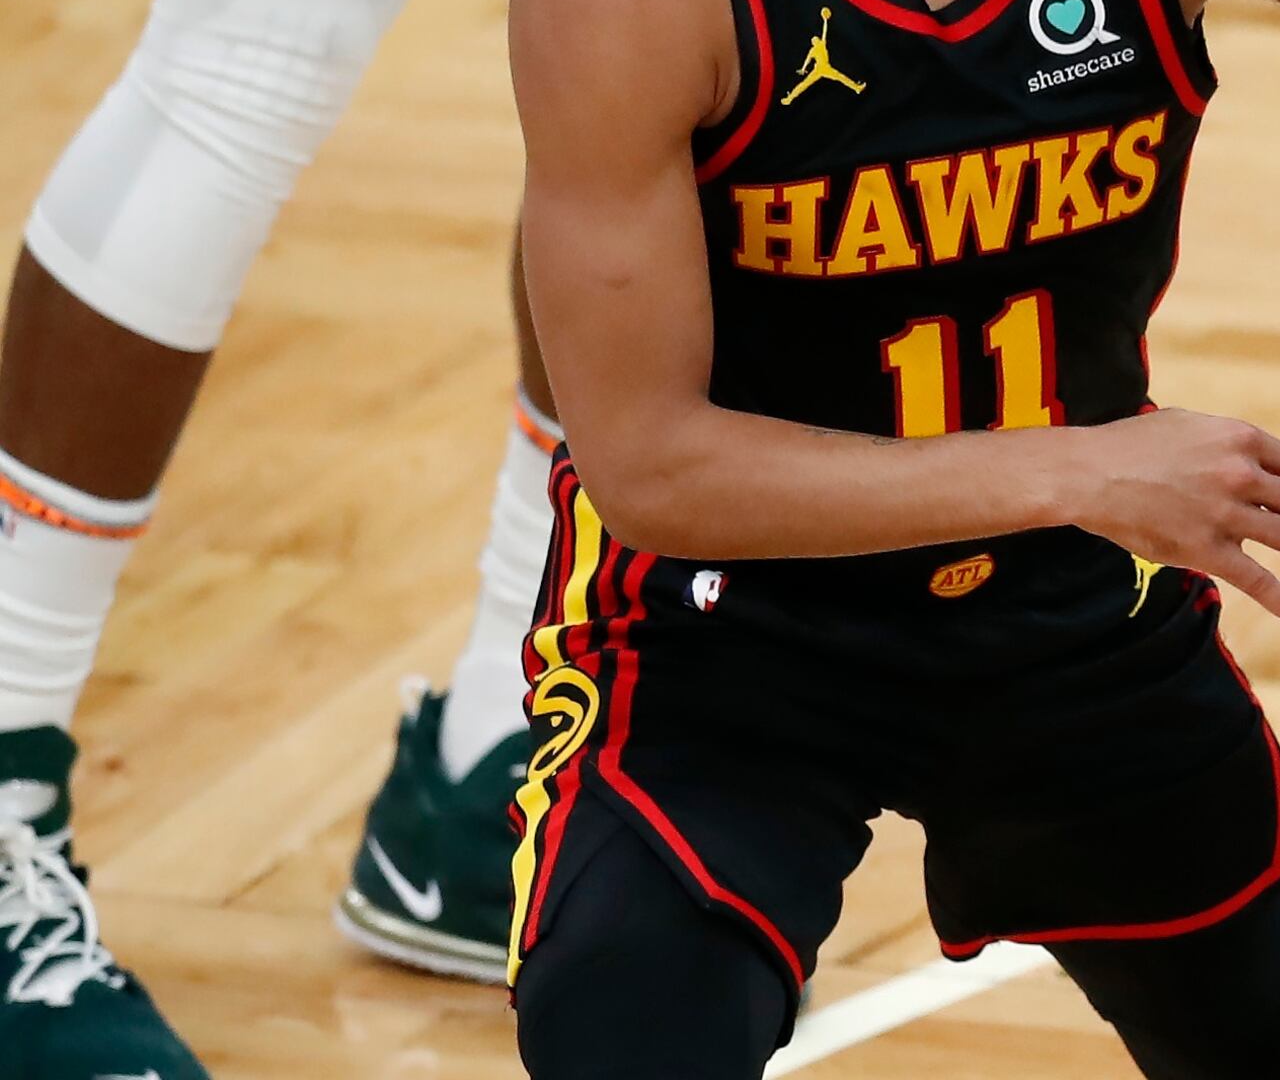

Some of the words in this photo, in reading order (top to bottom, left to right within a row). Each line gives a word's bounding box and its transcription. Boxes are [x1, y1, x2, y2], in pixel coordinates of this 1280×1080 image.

[1027, 46, 1136, 93] sharecare
[731, 111, 1166, 277] HAWKS
[880, 287, 1066, 440] 11
[939, 563, 984, 587] ATL
